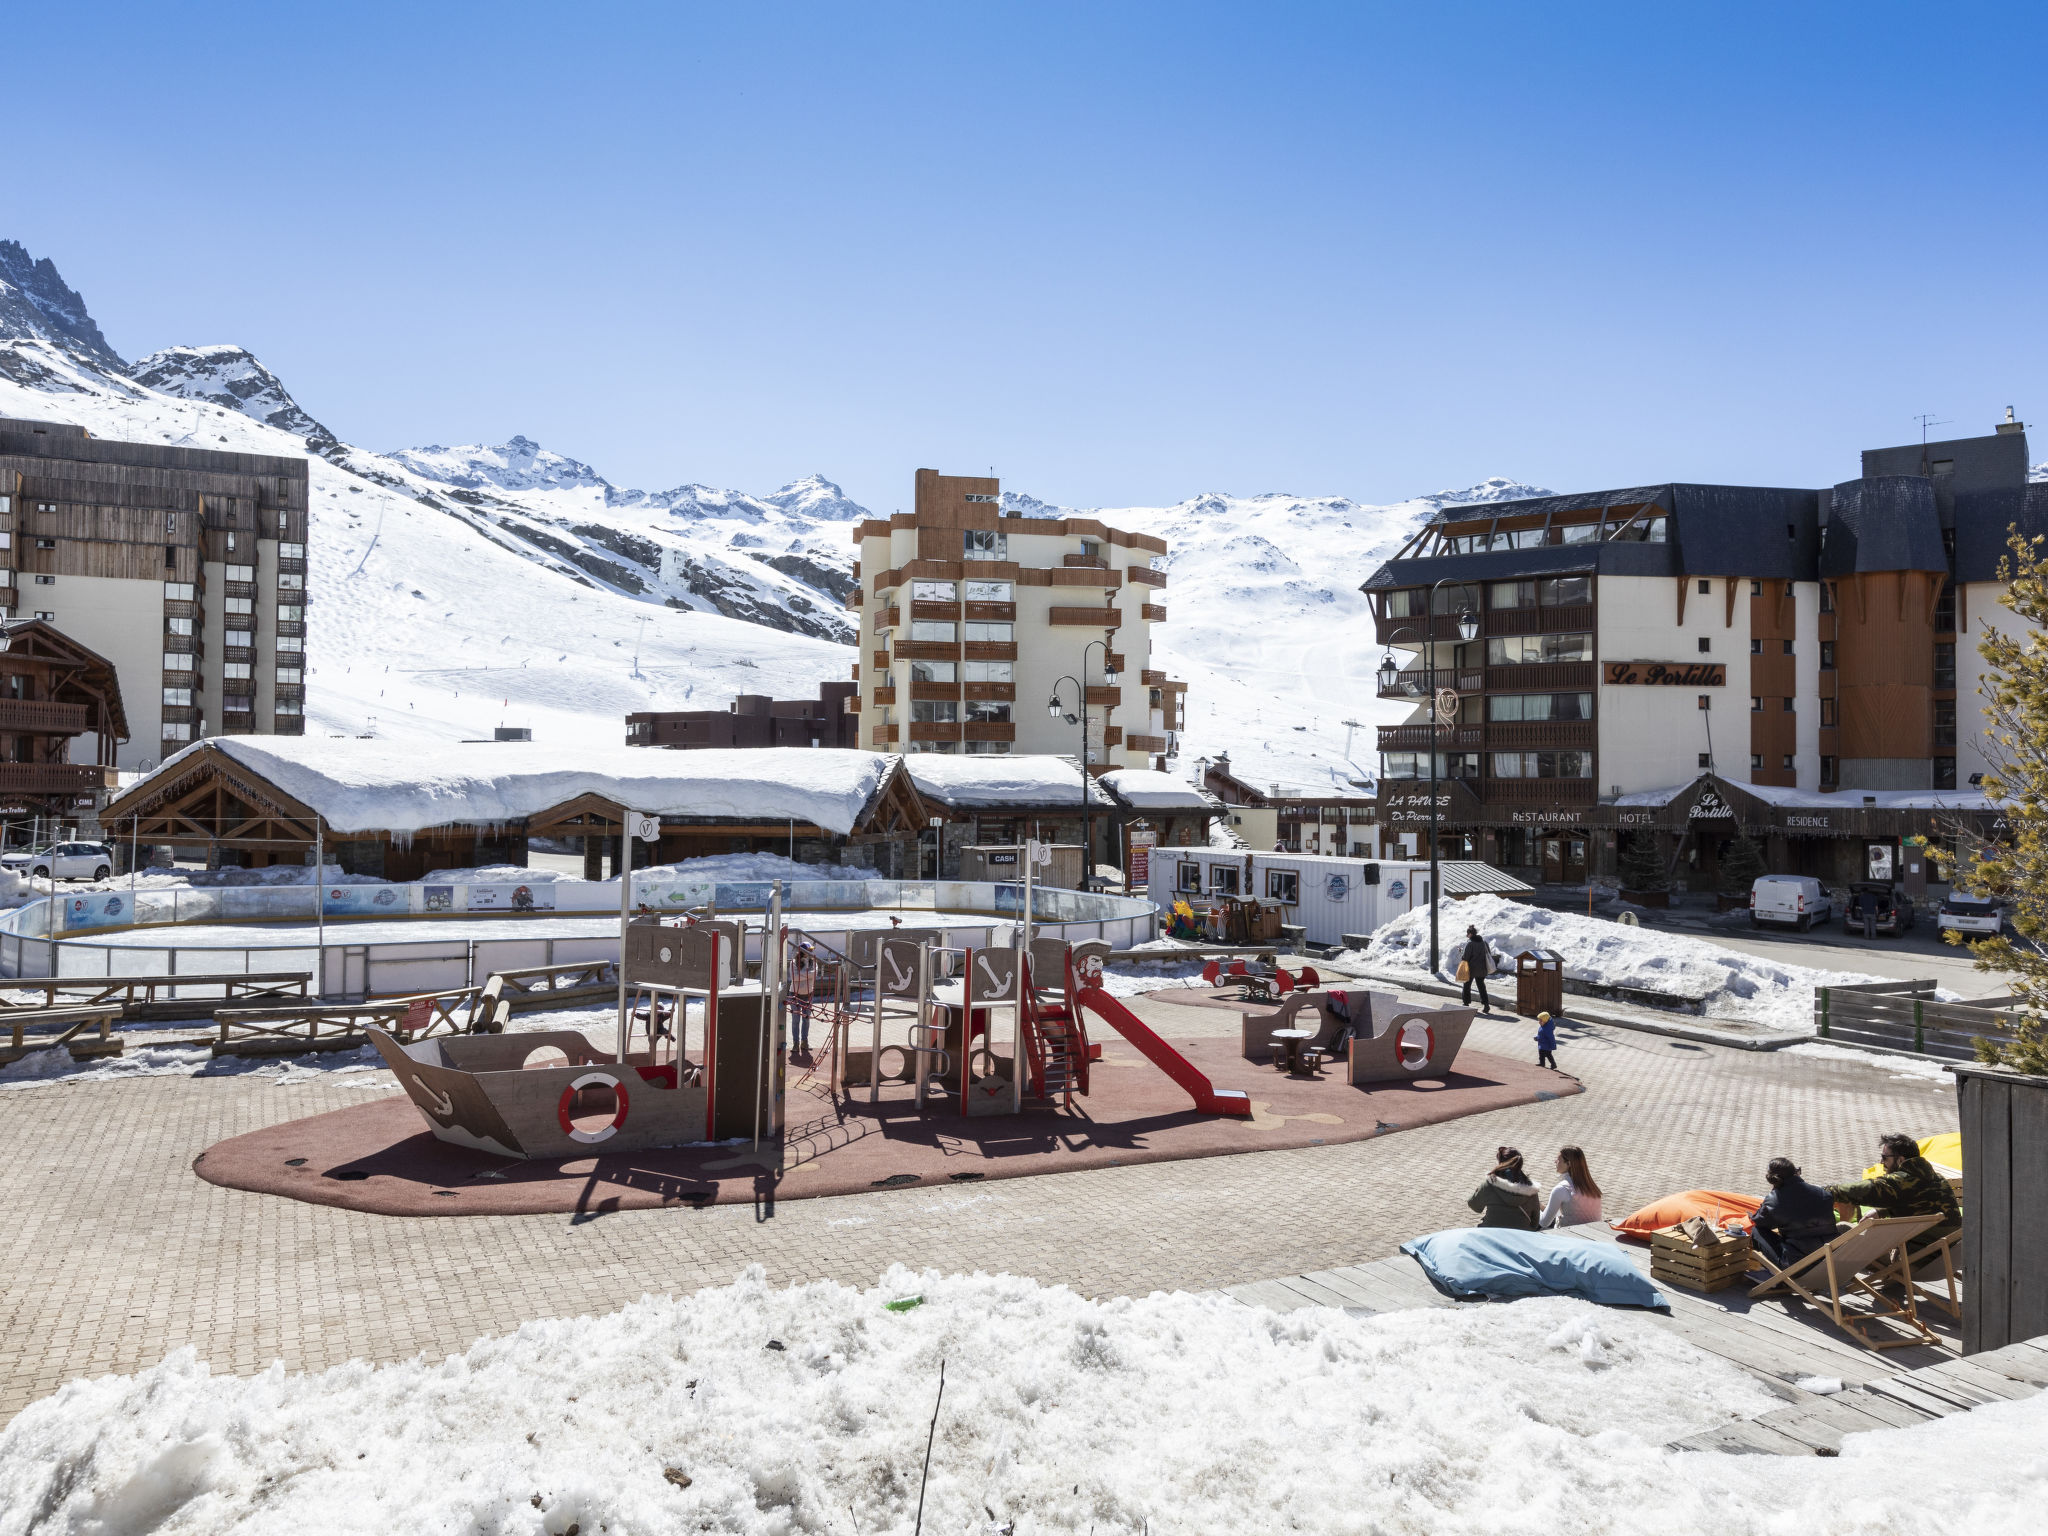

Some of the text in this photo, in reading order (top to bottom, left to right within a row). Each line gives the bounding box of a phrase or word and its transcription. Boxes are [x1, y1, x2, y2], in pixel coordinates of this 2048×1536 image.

[1609, 664, 1723, 686] Le Portillo
[1386, 794, 1405, 807] LA
[1701, 793, 1719, 807] Le
[1392, 810, 1446, 821] De Pierrte
[1512, 812, 1582, 822] RESTAURANT
[1689, 805, 1733, 819] Portillo
[1619, 813, 1655, 824] HOTEL
[1787, 816, 1829, 828] RESIDENCE
